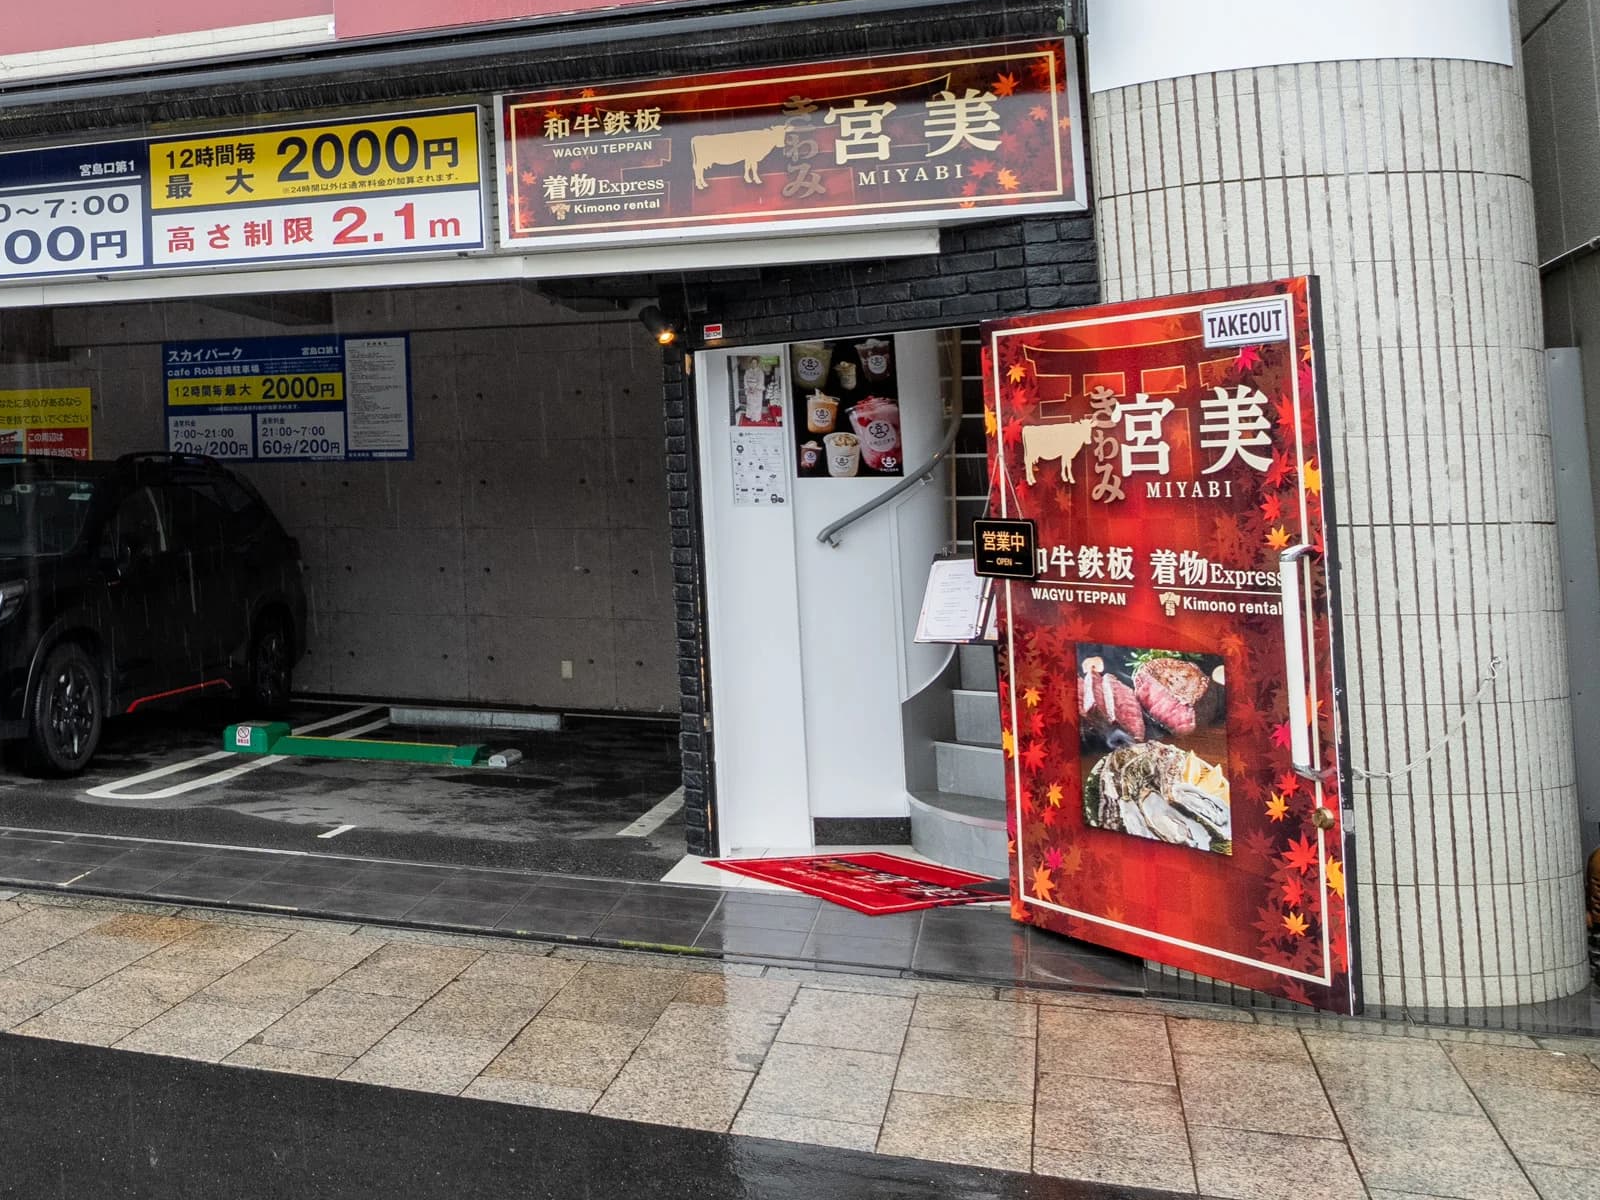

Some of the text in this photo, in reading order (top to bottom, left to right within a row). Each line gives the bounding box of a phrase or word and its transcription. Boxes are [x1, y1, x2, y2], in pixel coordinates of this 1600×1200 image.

[543, 107, 662, 141] 和牛鉄板
[824, 88, 1002, 165] 宮美
[165, 142, 256, 170] 12時間毎
[276, 126, 460, 183] 2000円
[553, 140, 652, 158] WAGYU TEPPAN
[80, 160, 135, 177] 宮島口第1
[858, 164, 963, 186] MIYABI
[165, 168, 254, 200] 最大
[574, 198, 660, 214] Kimono rental
[167, 217, 314, 254] 高さ制限
[1208, 310, 1282, 338] TAKEOUT
[168, 347, 243, 362] スカイパーク
[168, 366, 190, 377] cafe
[262, 376, 335, 400] 2000円
[1111, 384, 1274, 478] 宮美
[262, 438, 340, 455] 60分/200円
[1090, 386, 1125, 504] きわみ
[1146, 480, 1232, 498] MIYABI
[982, 530, 1025, 553] 営業中
[996, 558, 1012, 566] OPEN
[1031, 586, 1126, 606] WAGYU TEPPAN
[1183, 596, 1282, 616] Kimono rental
